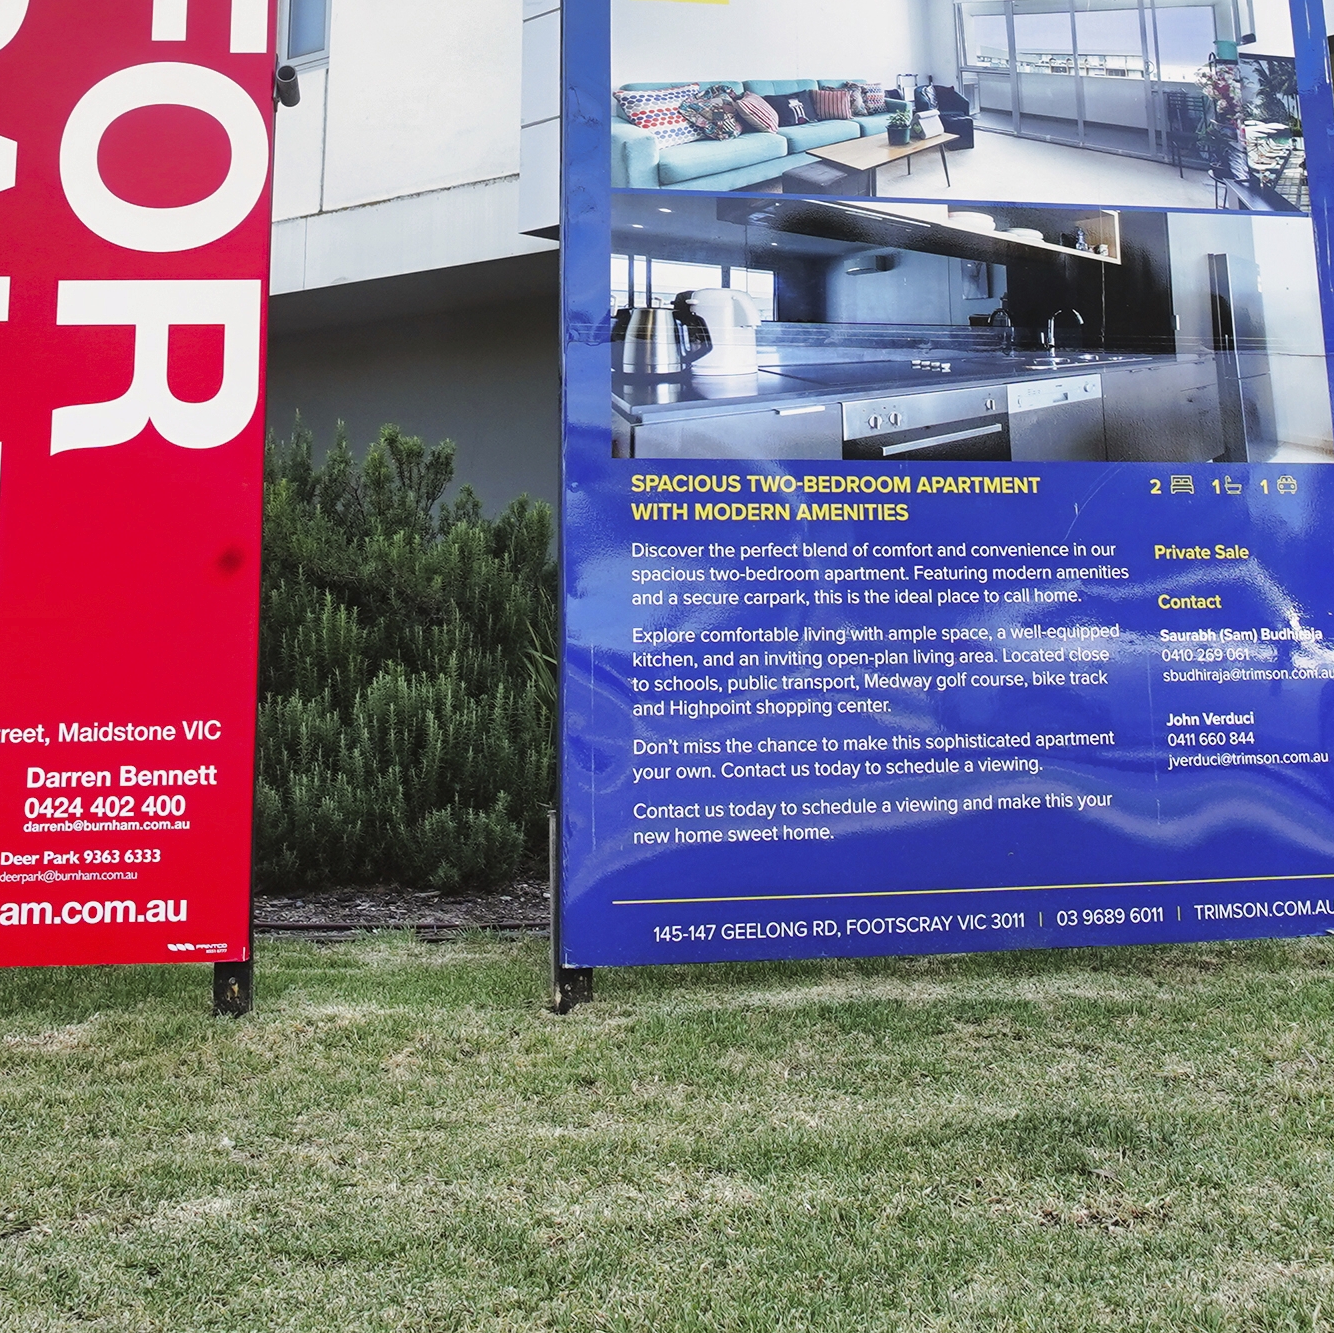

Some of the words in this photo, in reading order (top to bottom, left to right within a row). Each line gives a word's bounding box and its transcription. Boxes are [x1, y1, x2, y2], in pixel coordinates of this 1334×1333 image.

[631, 474, 741, 492] SPACIOUS
[746, 475, 911, 493] TWO-BEDROOM
[916, 476, 1041, 493] APARTMENT
[1150, 479, 1162, 494] 2
[1212, 479, 1221, 494] 1
[1260, 479, 1269, 494] 1
[630, 502, 688, 520] WITH
[694, 502, 790, 521] MODERN
[796, 503, 909, 521] AMENITIES
[631, 542, 704, 558] Discover
[708, 542, 735, 557] the
[740, 542, 798, 561] perfect
[802, 542, 847, 557] blend
[852, 542, 869, 557] of
[872, 542, 933, 557] comfort
[937, 542, 966, 557] and
[970, 542, 1069, 557] convenience
[1073, 542, 1086, 556] in
[1090, 544, 1116, 557] our
[1154, 544, 1211, 559] Private
[1214, 544, 1249, 559] Sale
[631, 566, 705, 584] spacious
[709, 565, 819, 581] two-bedroom
[824, 566, 909, 584] apartment.
[913, 565, 988, 584] Featuring
[992, 565, 1052, 580] modern
[1056, 564, 1129, 579] amenities
[631, 589, 663, 605] and
[668, 593, 678, 605] a
[682, 592, 739, 605] secure
[743, 589, 810, 608] carpark,
[813, 589, 843, 604] this
[847, 589, 860, 604] is
[863, 588, 890, 604] the
[894, 588, 932, 604] ideal
[937, 588, 980, 606] place
[983, 589, 1000, 603] to
[1003, 587, 1030, 603] call
[1034, 587, 1083, 603] home.
[1157, 594, 1222, 609] Contact
[1159, 628, 1216, 642] Saurabh
[1219, 627, 1258, 643] (Sam)
[632, 651, 697, 669] kitchen,
[702, 651, 734, 667] and
[739, 654, 759, 666] an
[764, 650, 822, 669] inviting
[827, 649, 908, 668] open-plan
[913, 648, 955, 667] living
[959, 651, 998, 663] area.
[1002, 646, 1065, 663] Located
[1068, 646, 1110, 663] close
[1161, 648, 1194, 662] 0410
[1194, 647, 1223, 662] 269
[1226, 647, 1250, 661] 061
[1166, 712, 1200, 726] John
[1201, 711, 1254, 725] Verduci
[58, 721, 176, 742] Maidstone
[181, 719, 221, 740] VIC
[1167, 733, 1196, 746] 0411
[1198, 731, 1226, 746] 660
[1229, 731, 1255, 745] 844
[1167, 752, 1329, 770] jverduci@trimson.com.au
[26, 766, 111, 788] Darren
[119, 765, 217, 786] Bennett
[24, 796, 83, 819] 0424
[89, 795, 135, 817] 402
[140, 794, 186, 816] 400
[22, 819, 190, 832] darrenb@burnham.com.au
[0, 851, 40, 865] Deer
[43, 850, 80, 864] Park
[83, 849, 120, 864] 9363
[124, 848, 161, 863] 6333
[653, 924, 716, 942] 145-147
[721, 920, 807, 940] GEELONG
[812, 920, 841, 938] RD,
[846, 915, 953, 935] FOOTSCRAY
[957, 913, 987, 930] VIC
[991, 912, 1024, 929] 3011
[1056, 909, 1078, 926] 03
[1082, 908, 1125, 925] 9689
[1129, 906, 1163, 923] 6011
